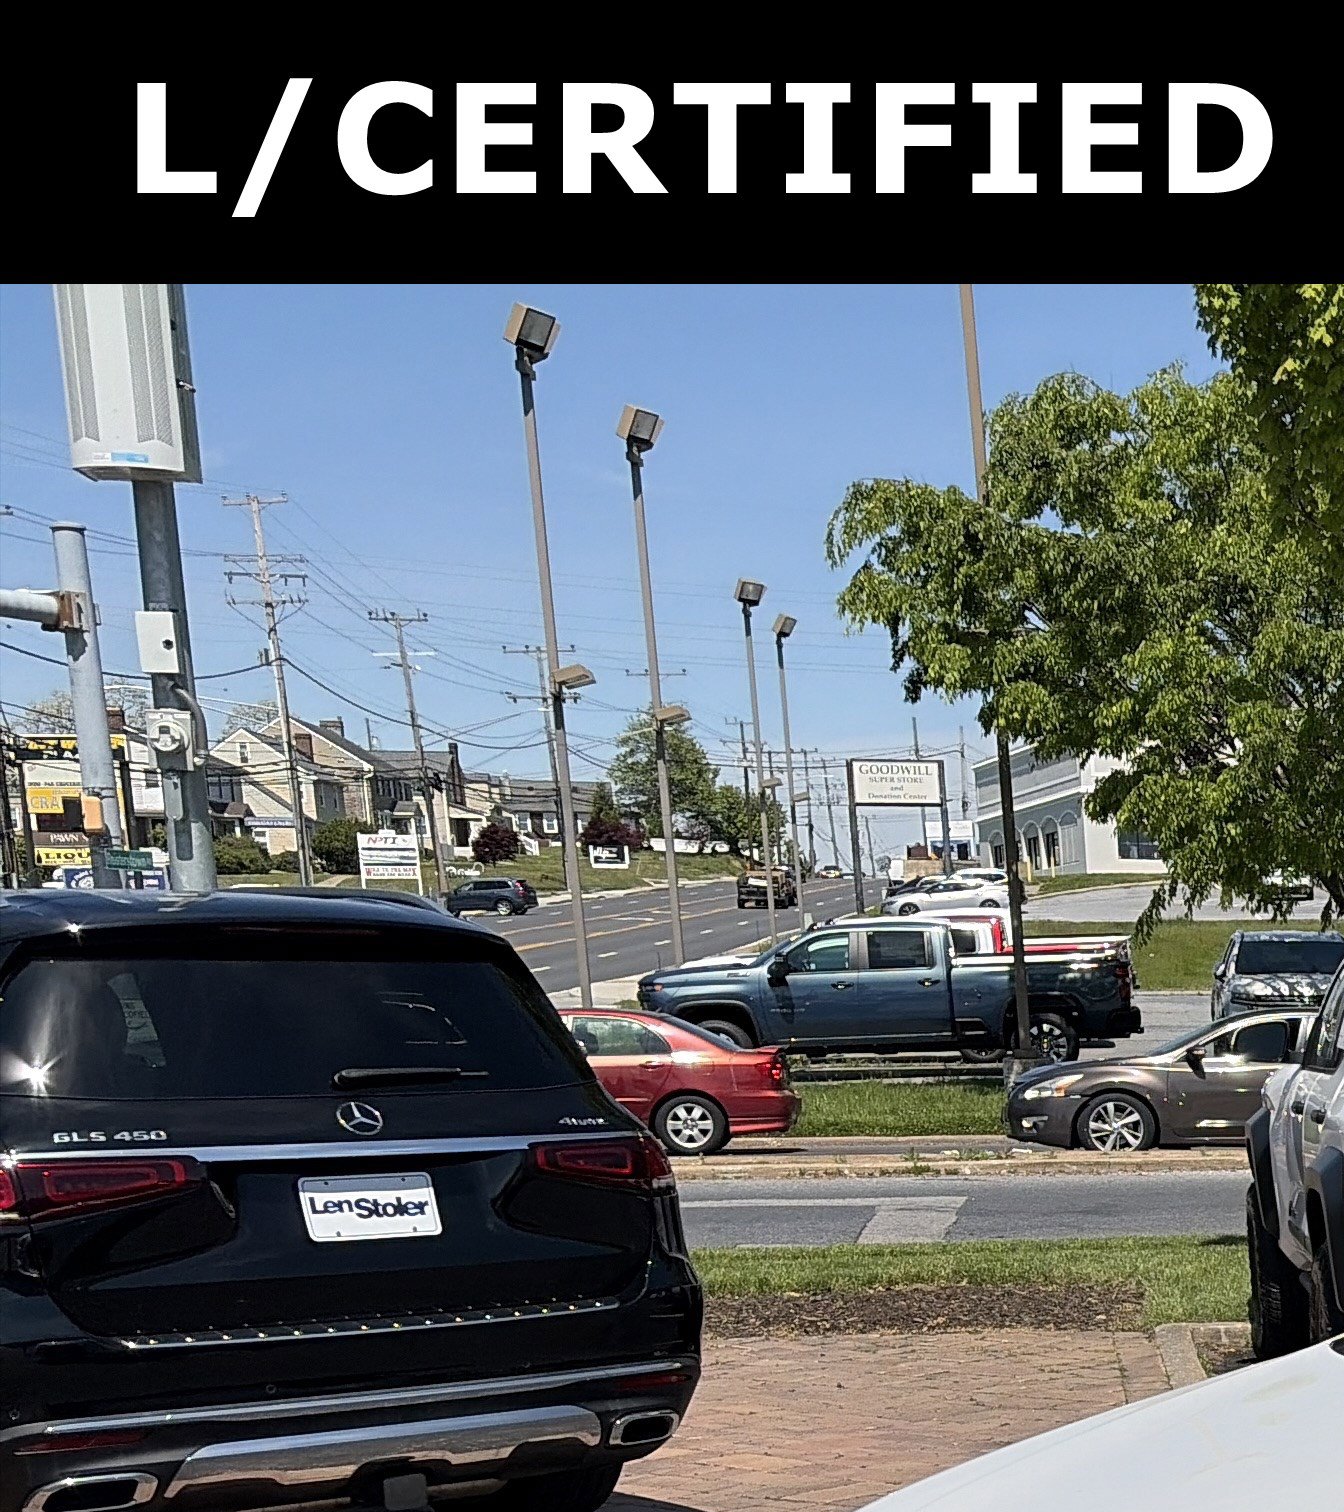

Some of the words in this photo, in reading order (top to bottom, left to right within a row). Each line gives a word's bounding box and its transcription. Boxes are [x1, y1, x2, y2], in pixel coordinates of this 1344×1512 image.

[859, 764, 932, 776] GOODWILL
[897, 776, 924, 784] STORE
[30, 796, 61, 809] CRA
[50, 833, 79, 843] PAWN
[45, 852, 91, 860] LIQU
[53, 1131, 106, 1143] GLS
[113, 1130, 167, 1141] 450
